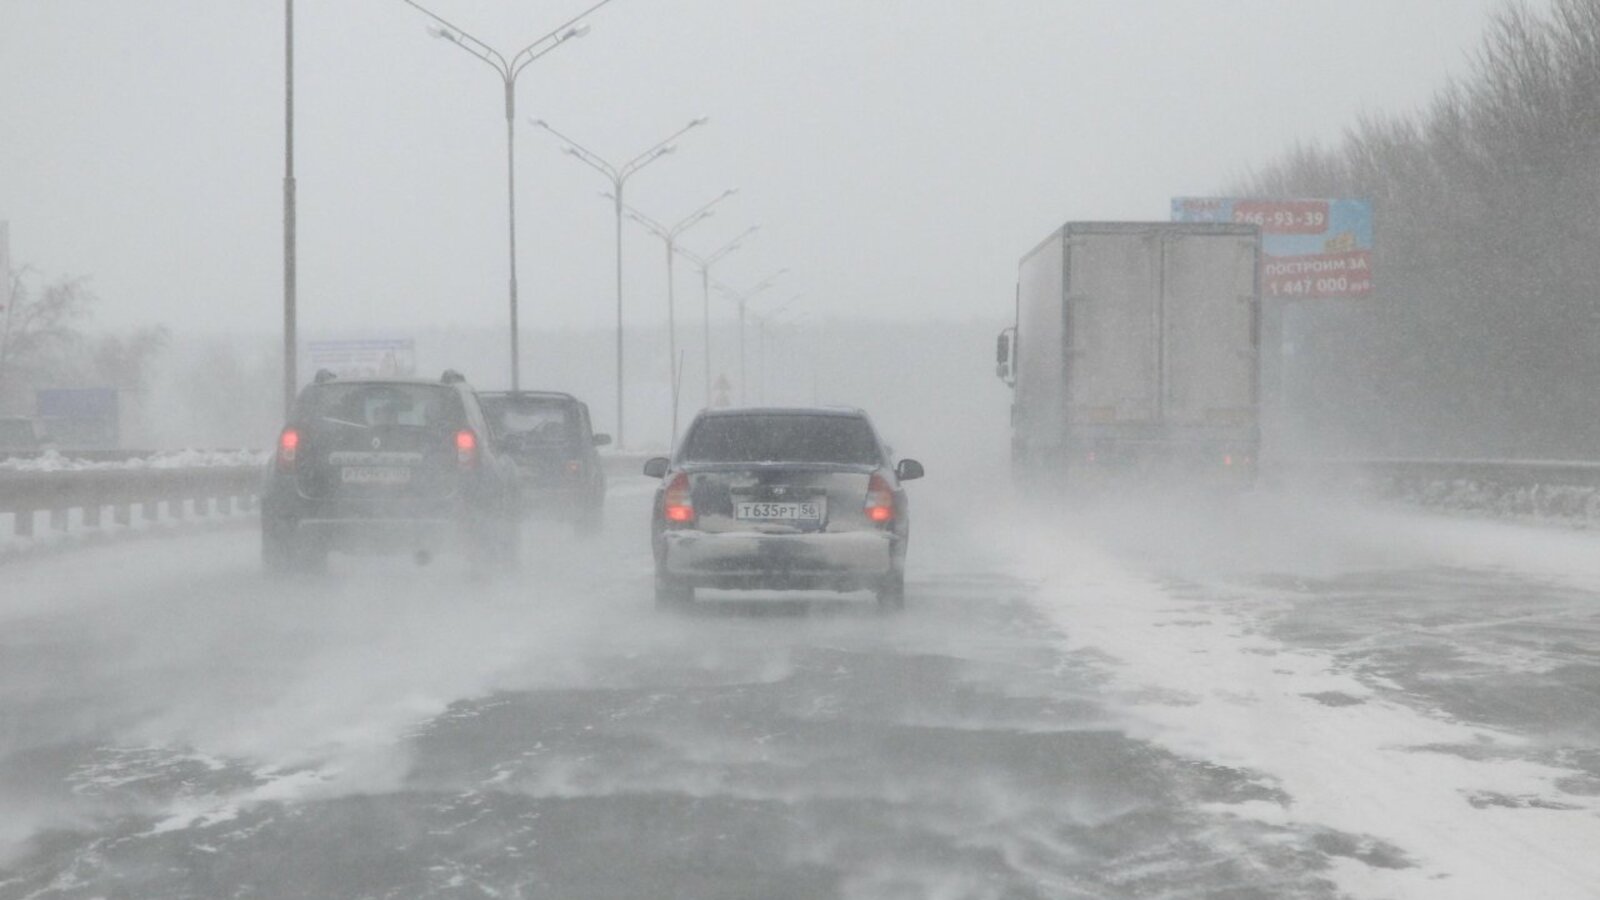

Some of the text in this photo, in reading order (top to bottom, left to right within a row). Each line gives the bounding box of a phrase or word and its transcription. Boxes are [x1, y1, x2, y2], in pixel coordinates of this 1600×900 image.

[1265, 258, 1367, 276] ПОСТРОИМ ЗА
[1316, 277, 1348, 292] 000
[801, 504, 816, 515] 56
